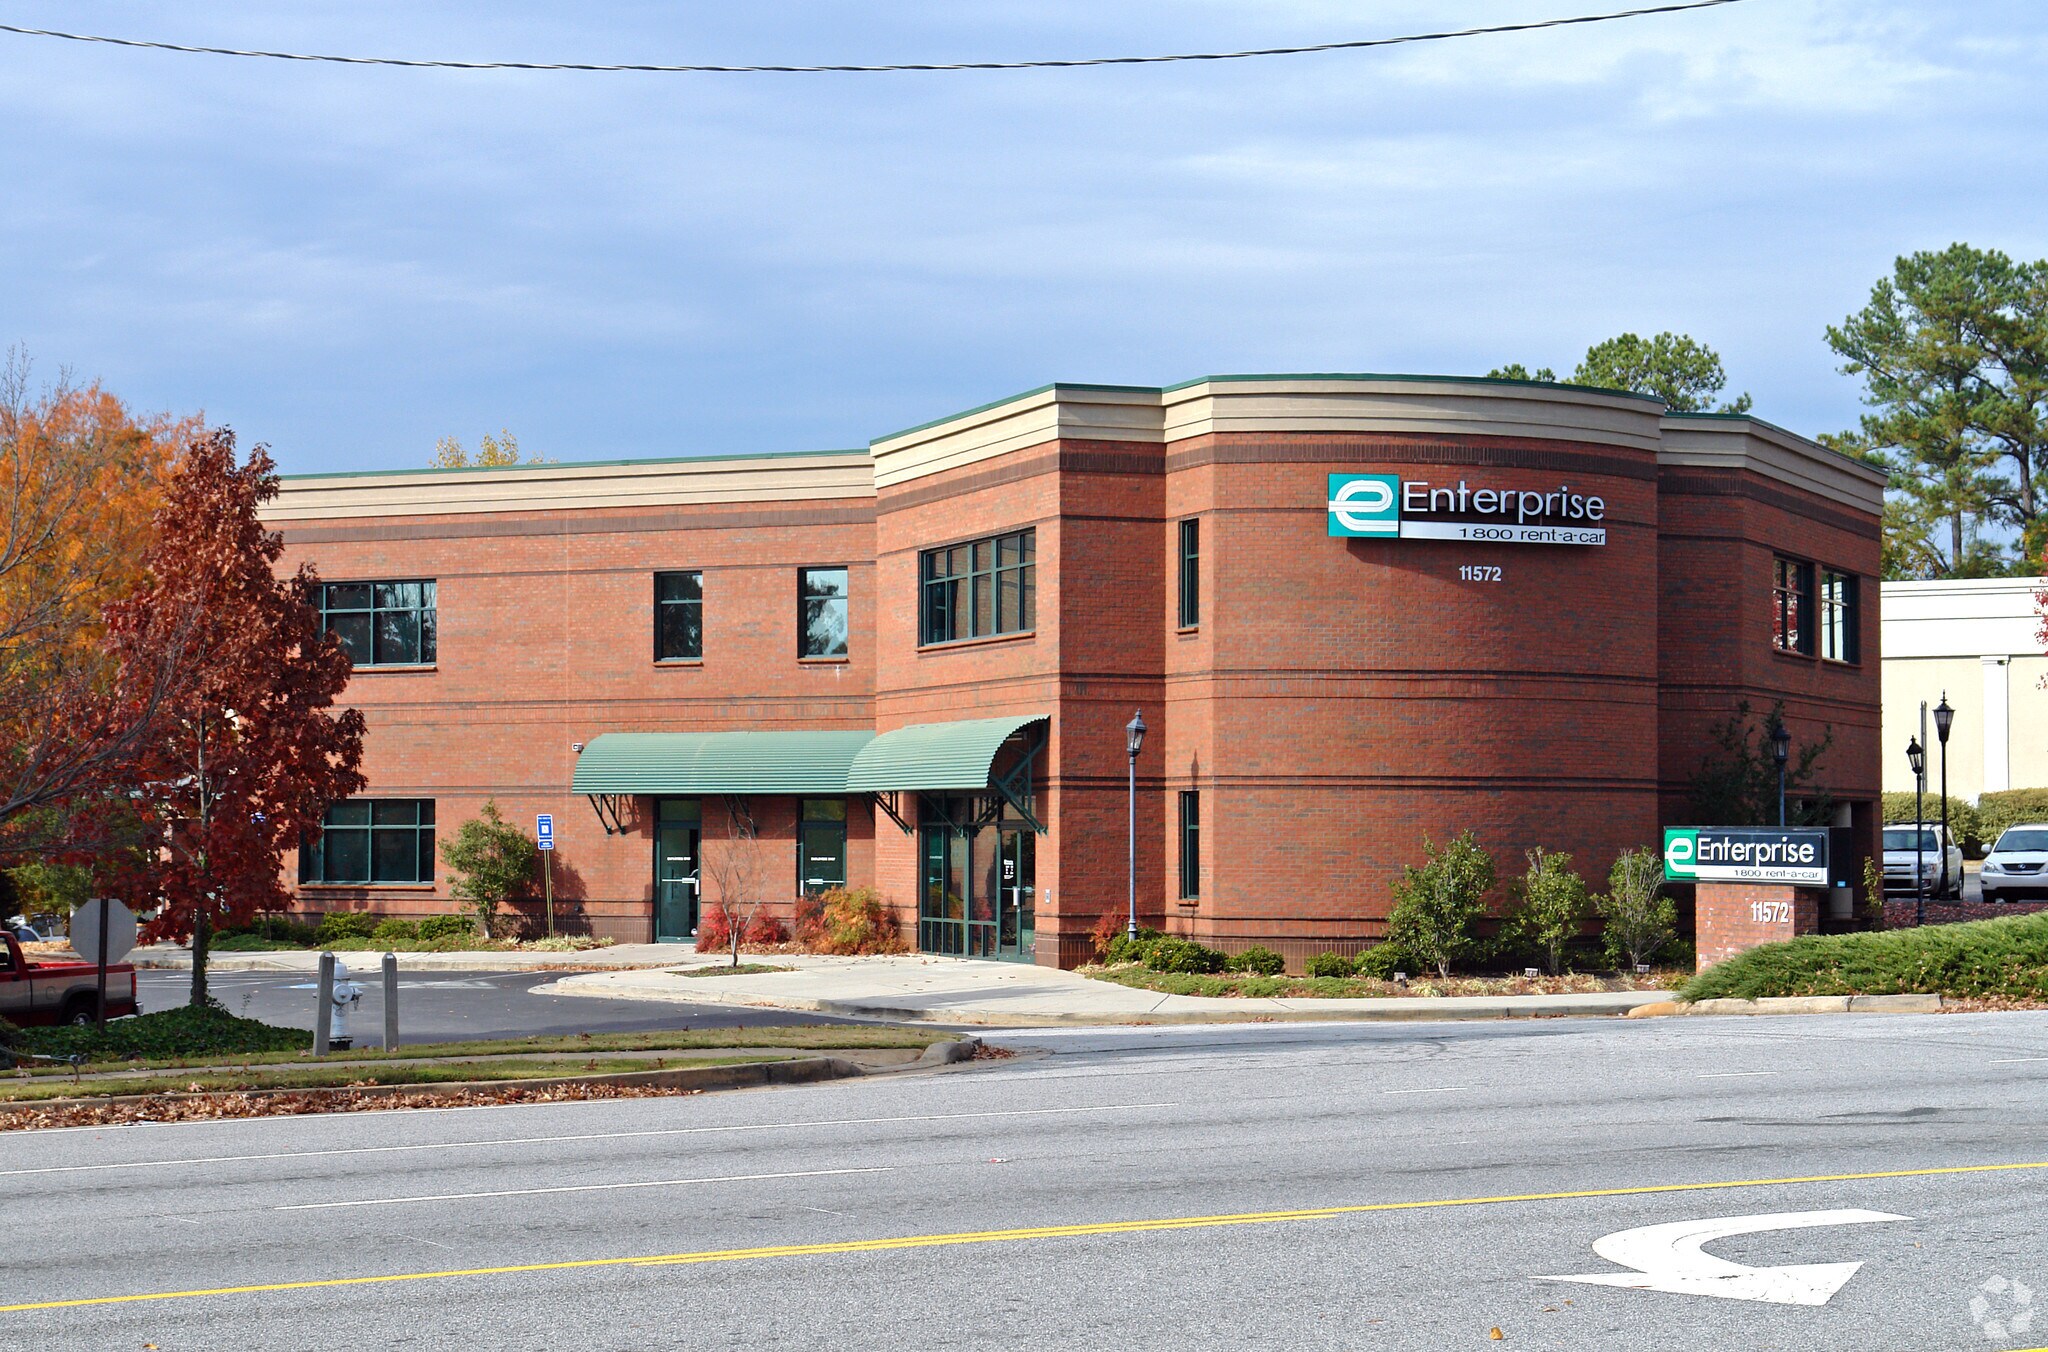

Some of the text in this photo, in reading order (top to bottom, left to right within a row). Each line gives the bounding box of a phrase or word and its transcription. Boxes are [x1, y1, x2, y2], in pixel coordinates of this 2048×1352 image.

[1402, 480, 1605, 524] Enterprise
[1520, 530, 1605, 543] rent-a-car
[1458, 565, 1502, 582] 11572
[1697, 836, 1815, 868] Enterprise
[1765, 869, 1820, 879] rent-a-car
[1751, 901, 1789, 923] 11572
